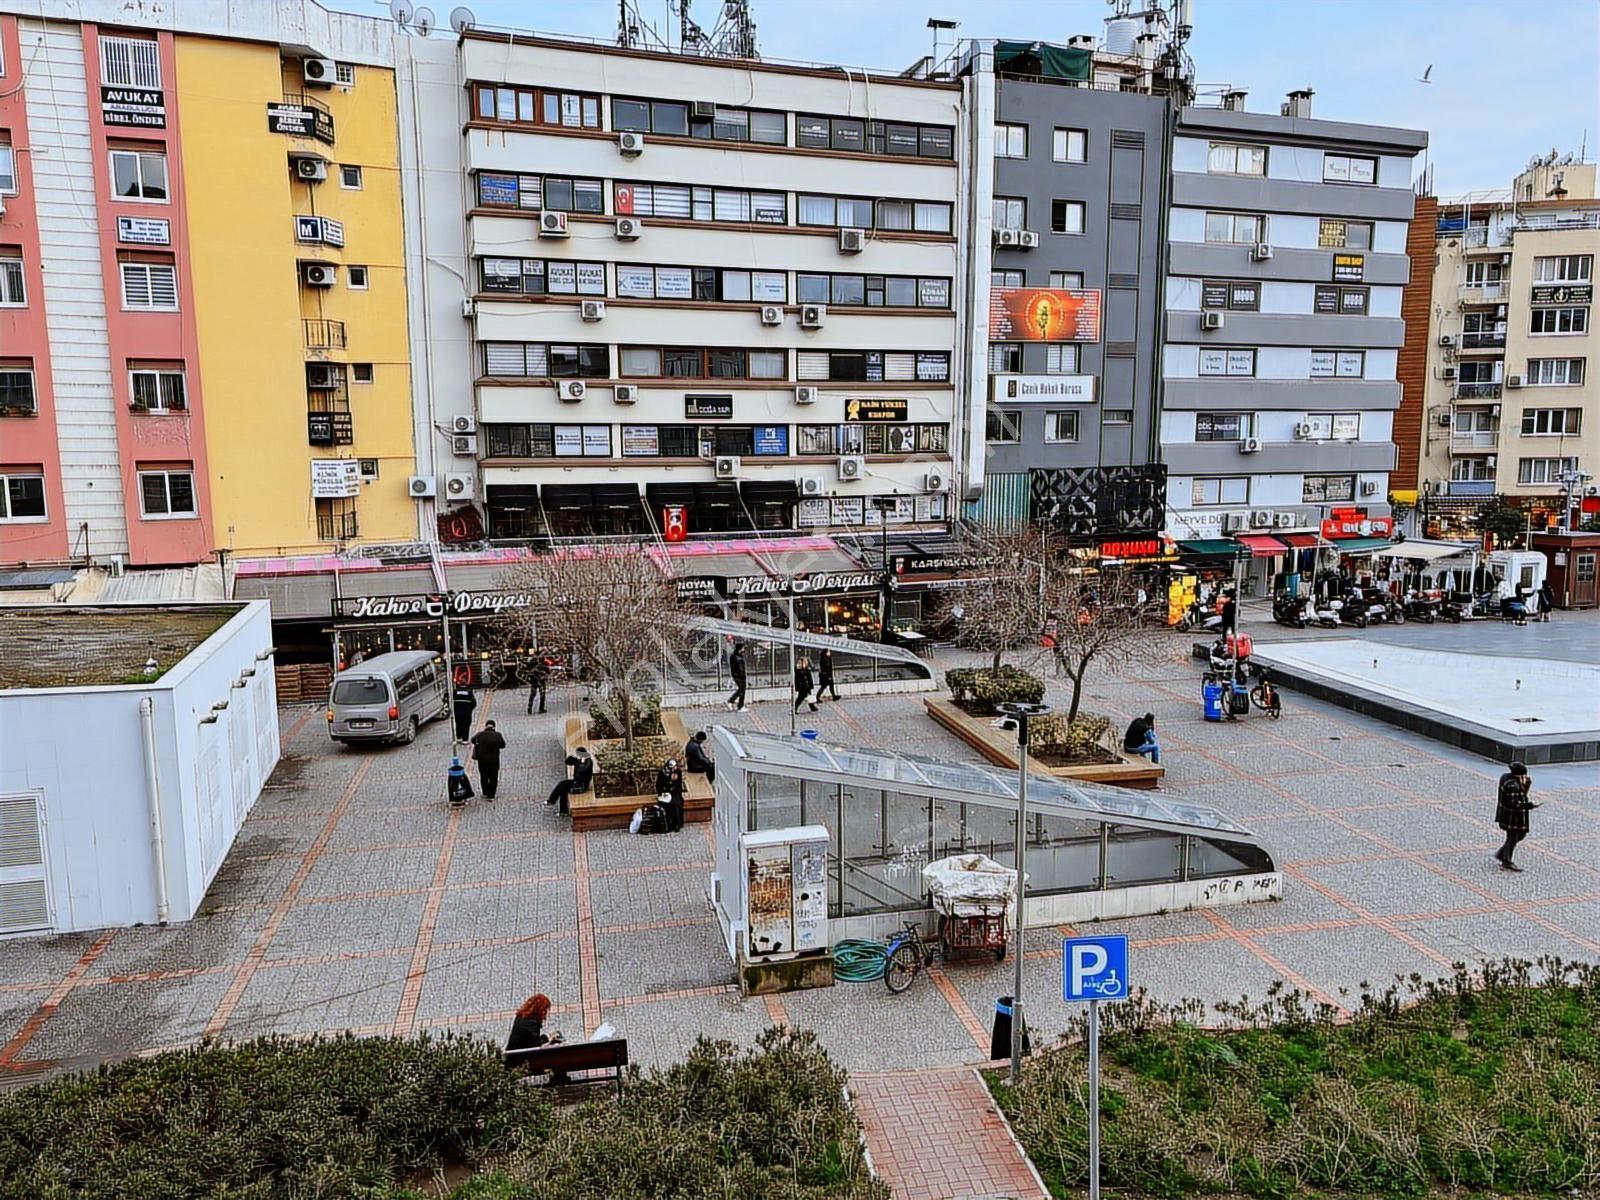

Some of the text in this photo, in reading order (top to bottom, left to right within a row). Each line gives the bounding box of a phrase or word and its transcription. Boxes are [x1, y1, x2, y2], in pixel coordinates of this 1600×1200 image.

[107, 90, 159, 104] AVUKAT
[131, 113, 165, 126] ÖNDER
[677, 580, 715, 590] NOYAN
[735, 577, 789, 595] Kahve
[352, 595, 422, 617] Kahve
[1072, 944, 1108, 996] P
